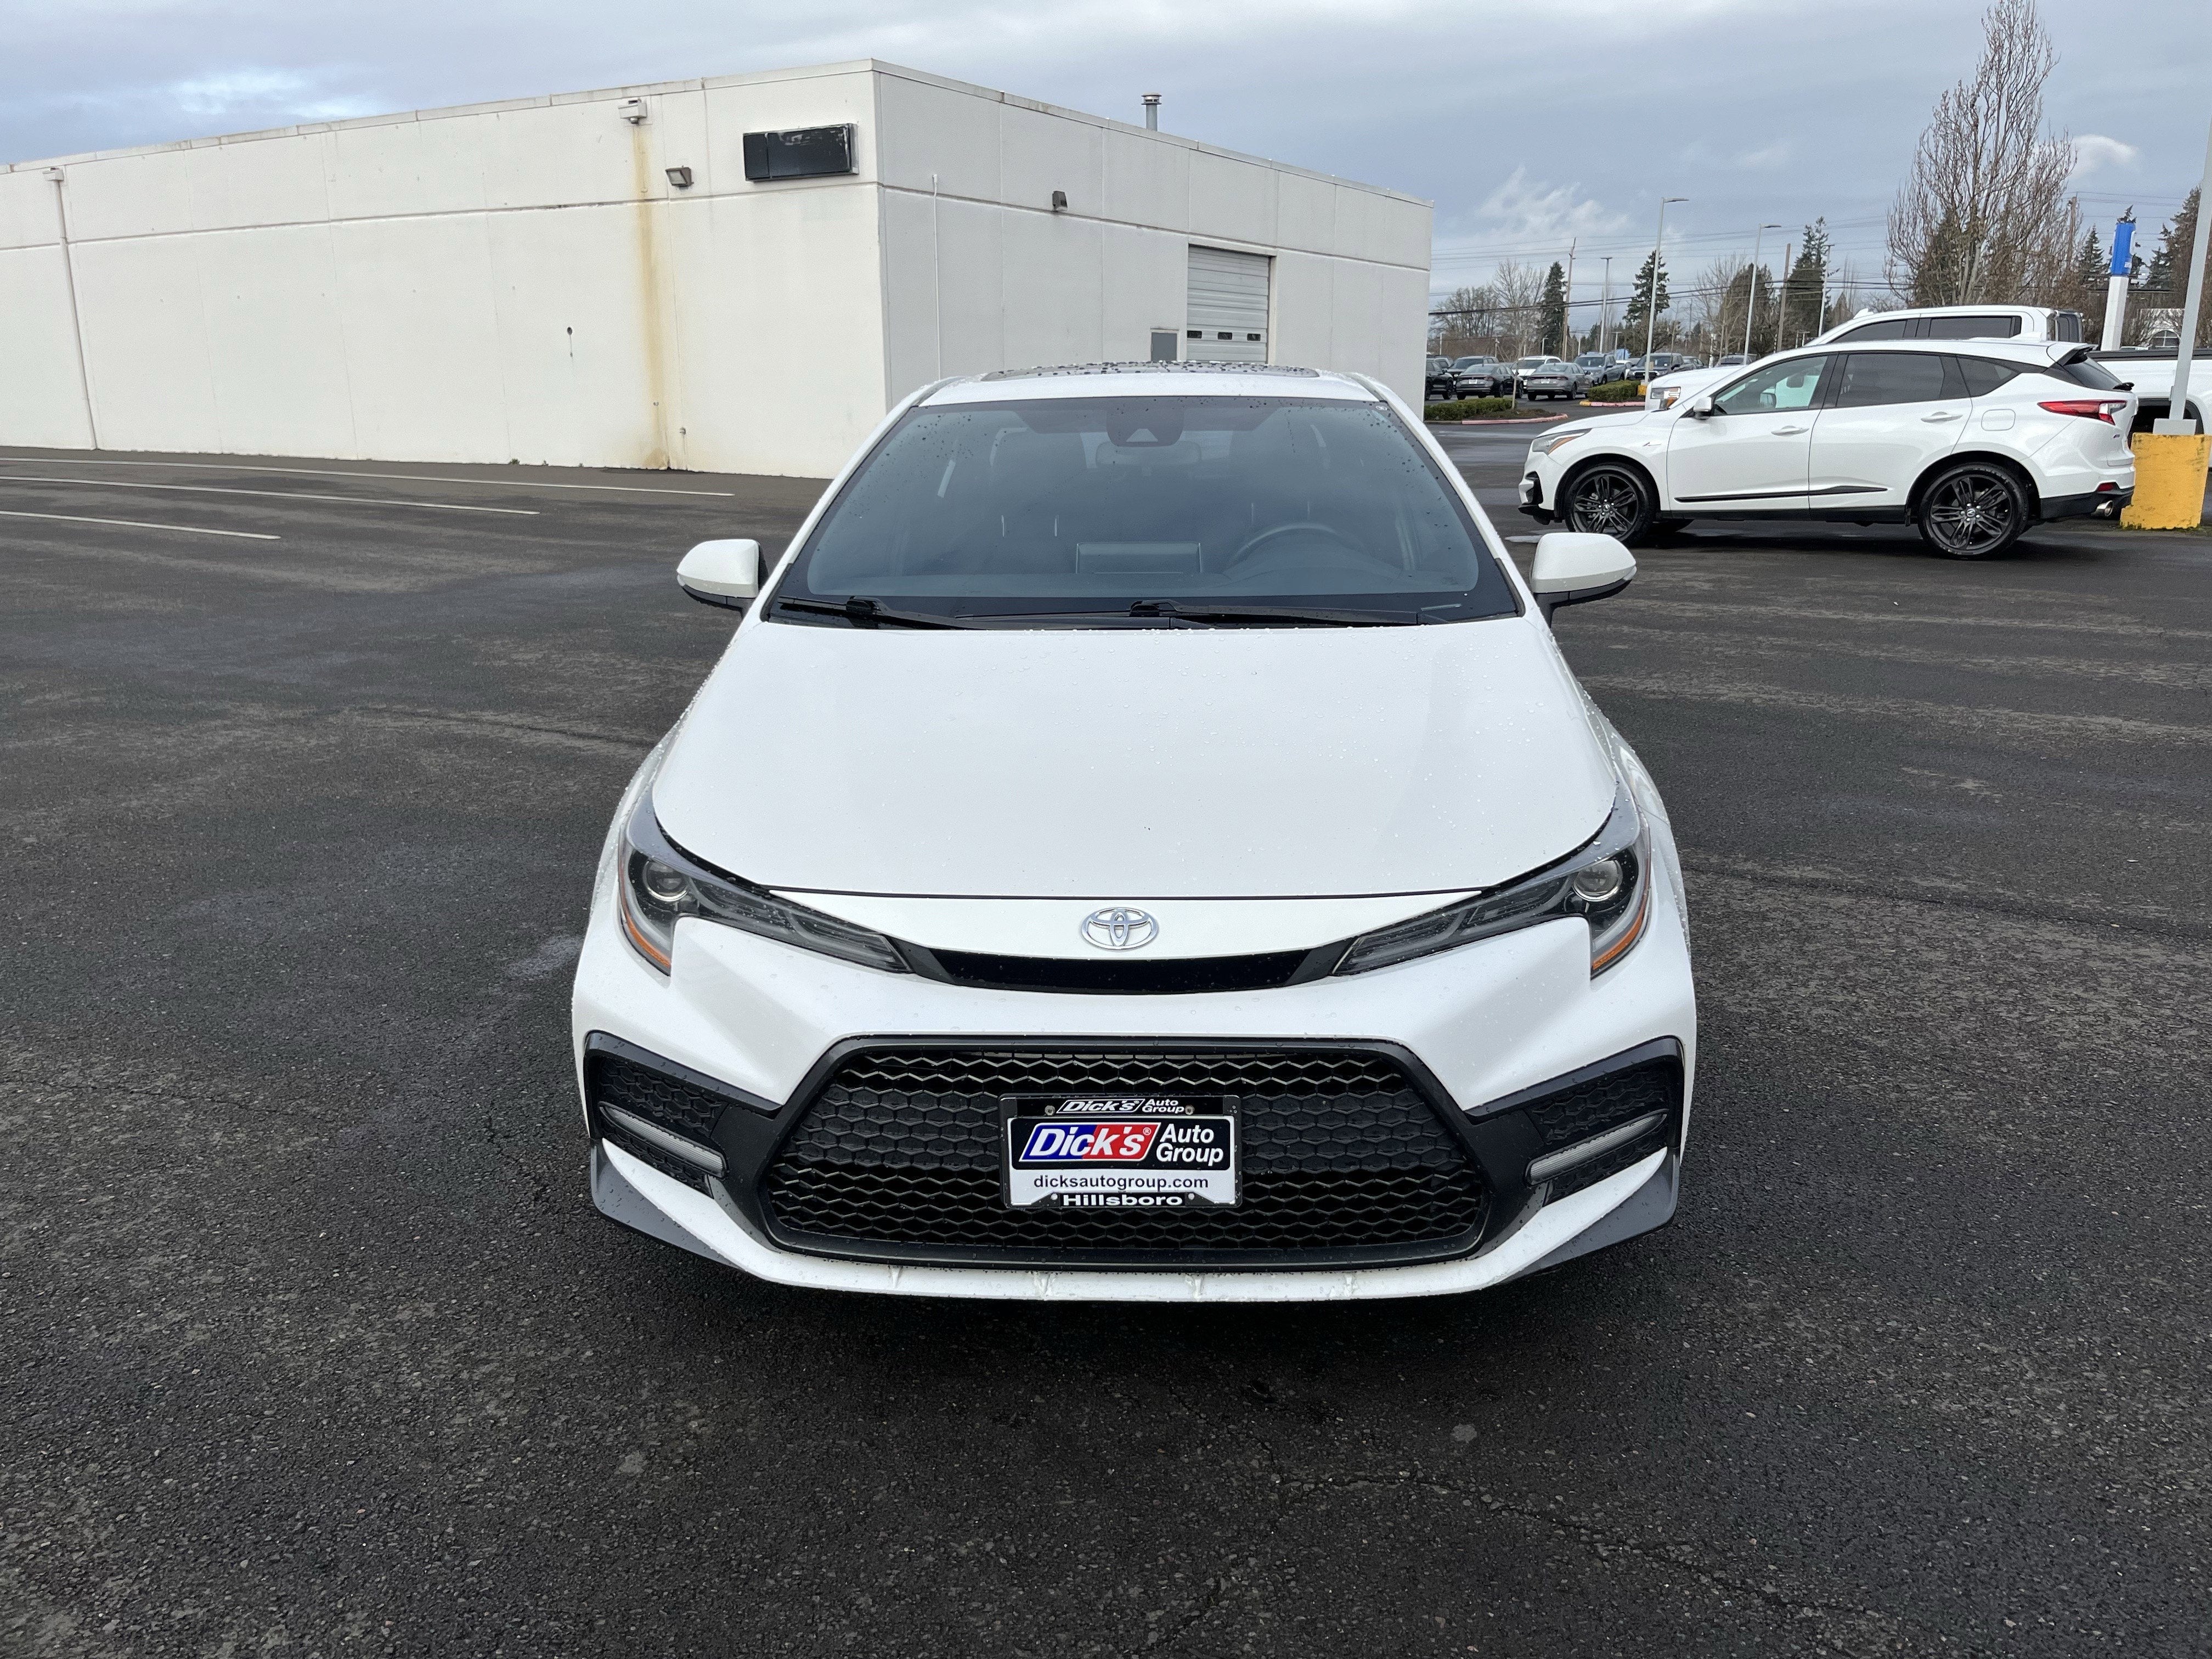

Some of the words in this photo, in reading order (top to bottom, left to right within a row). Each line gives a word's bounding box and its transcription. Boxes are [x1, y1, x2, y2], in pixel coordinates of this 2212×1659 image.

[1142, 1105, 1185, 1114] Group
[1029, 1126, 1144, 1156] Dick's
[1160, 1124, 1214, 1143] Auto
[1156, 1143, 1223, 1166] Group
[1034, 1175, 1209, 1192] dicksautogroup.com
[1063, 1194, 1183, 1206] Hillsboro
